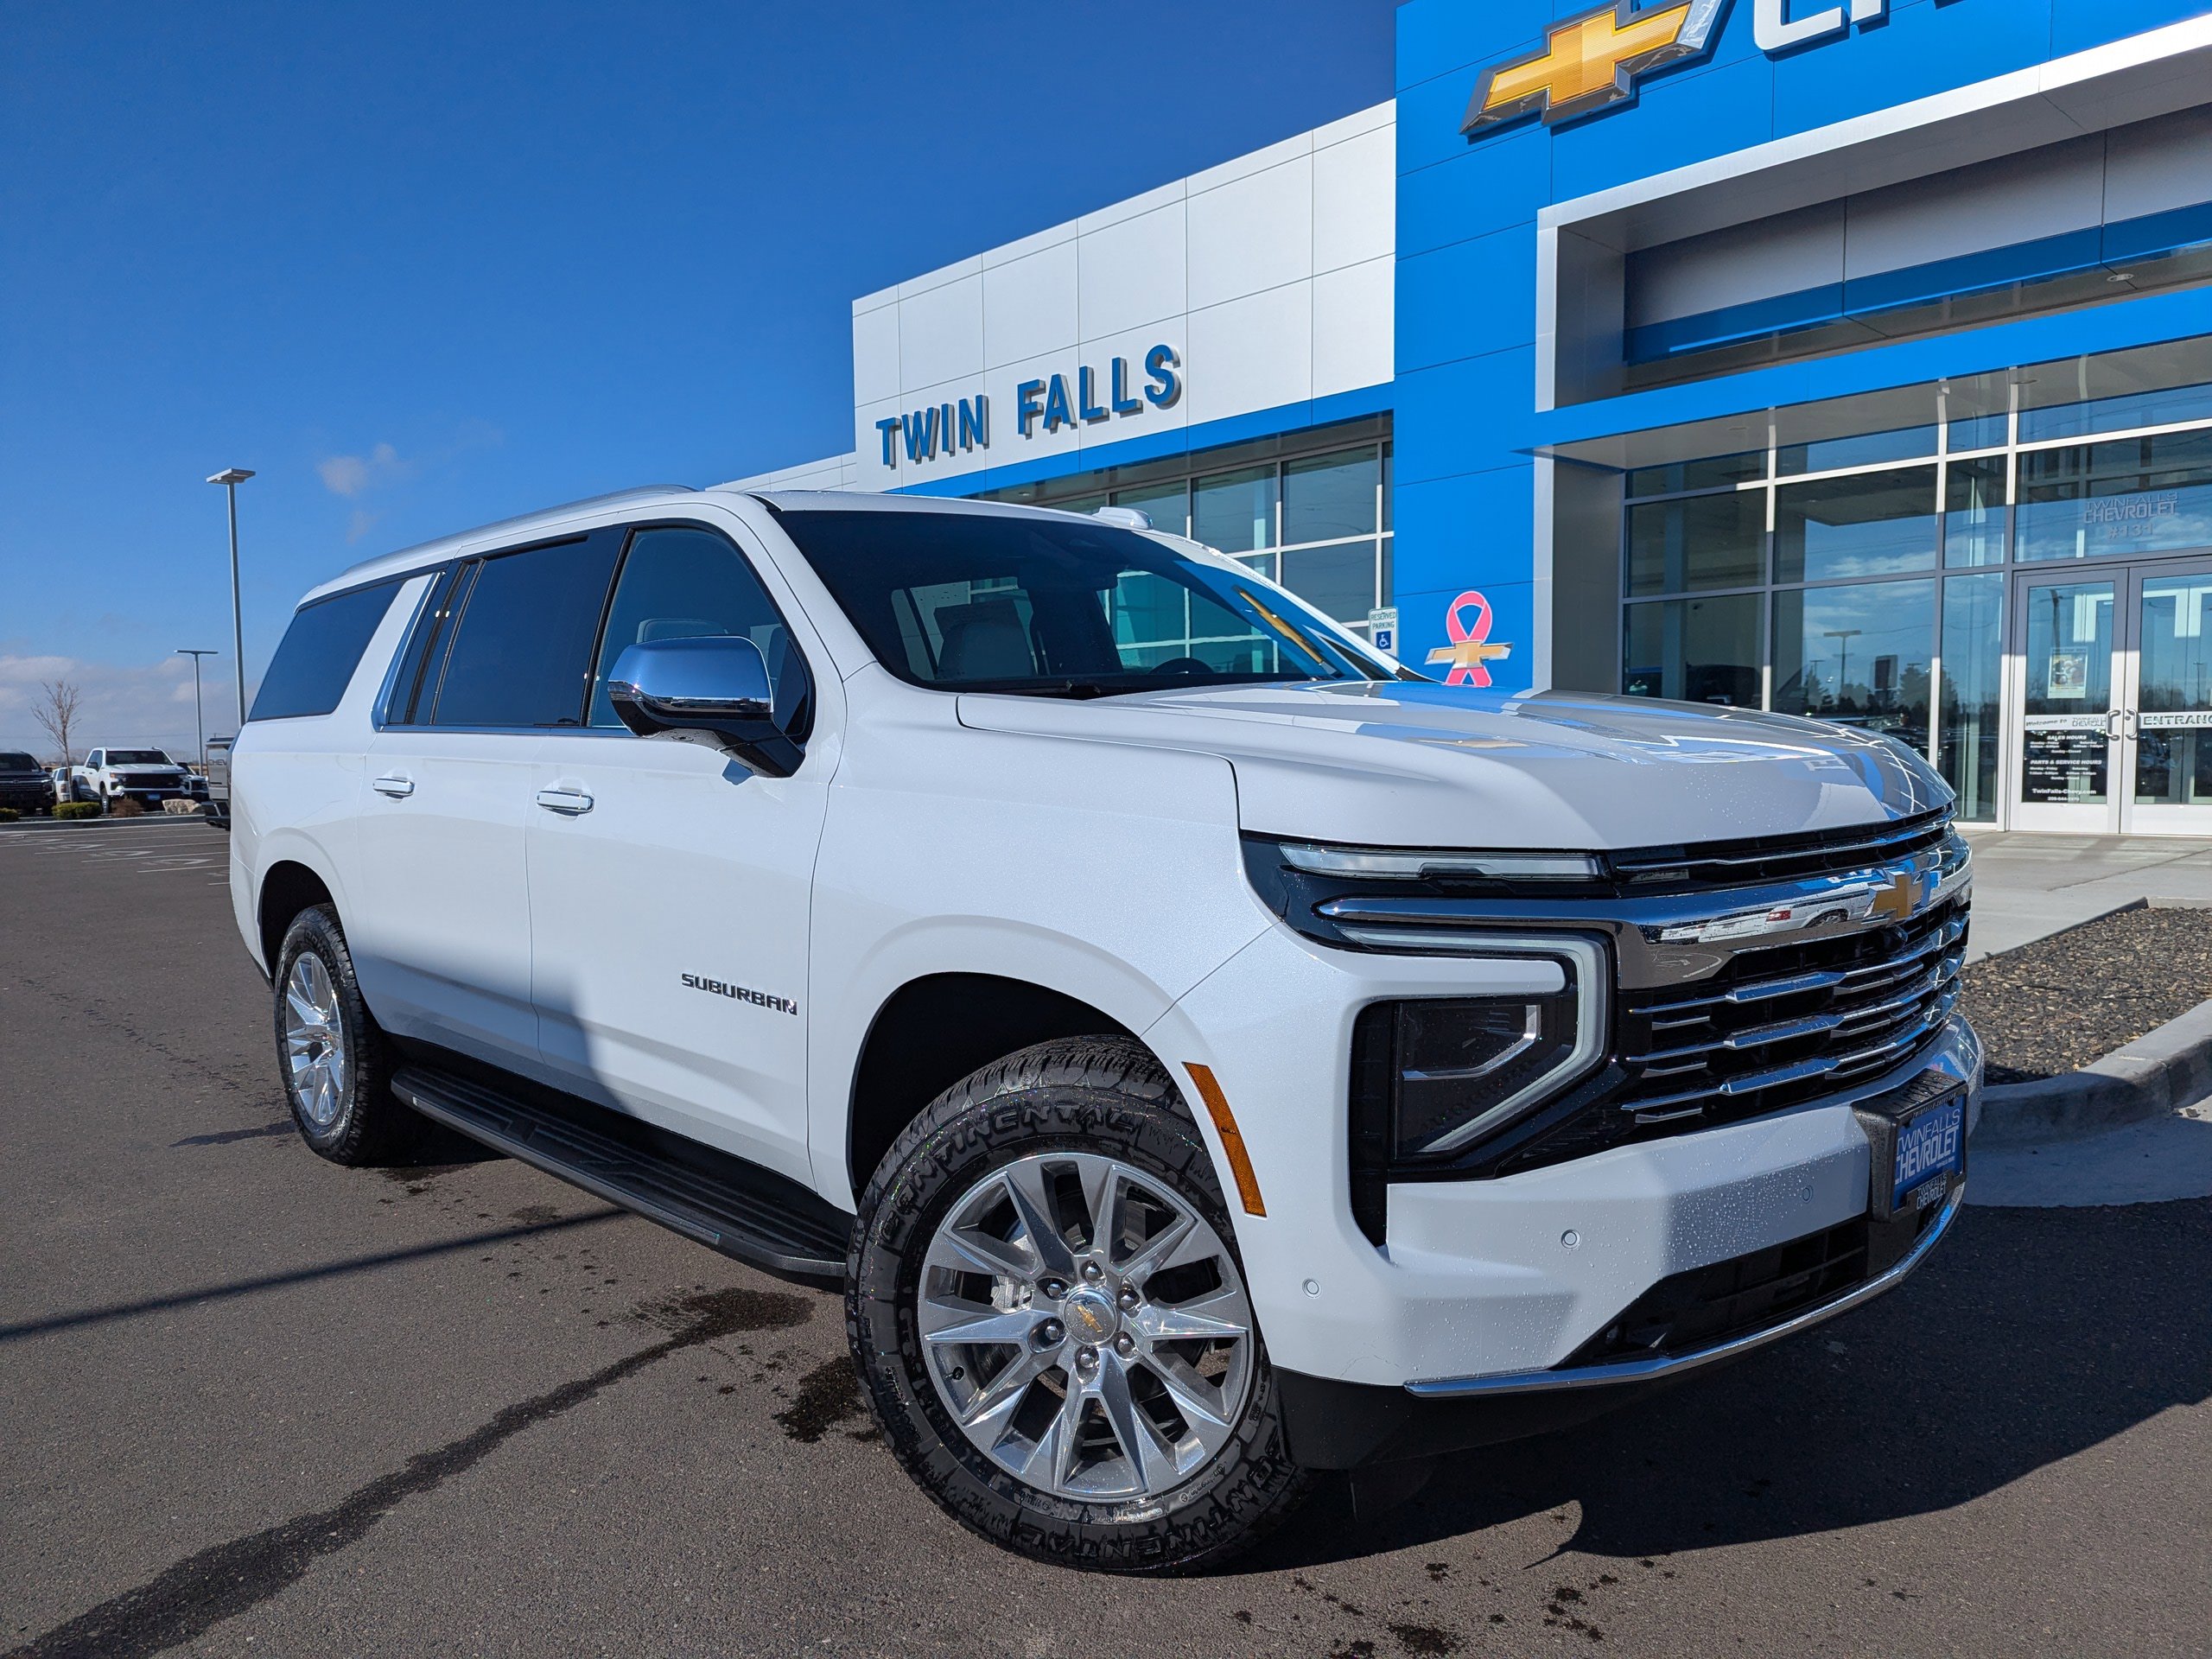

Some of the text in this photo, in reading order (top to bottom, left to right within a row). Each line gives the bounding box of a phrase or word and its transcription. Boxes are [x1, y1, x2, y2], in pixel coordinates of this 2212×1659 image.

[875, 344, 1181, 470] TWIN FALLS
[2084, 500, 2178, 524] CHEVROLET
[2108, 524, 2153, 539] #131
[1370, 612, 1396, 620] RESERVED
[1372, 621, 1395, 630] PARKING
[682, 973, 798, 1016] SUBURBAN
[1897, 1109, 1961, 1155] TWINFALLS
[1916, 1182, 1947, 1211] CHEVROLET
